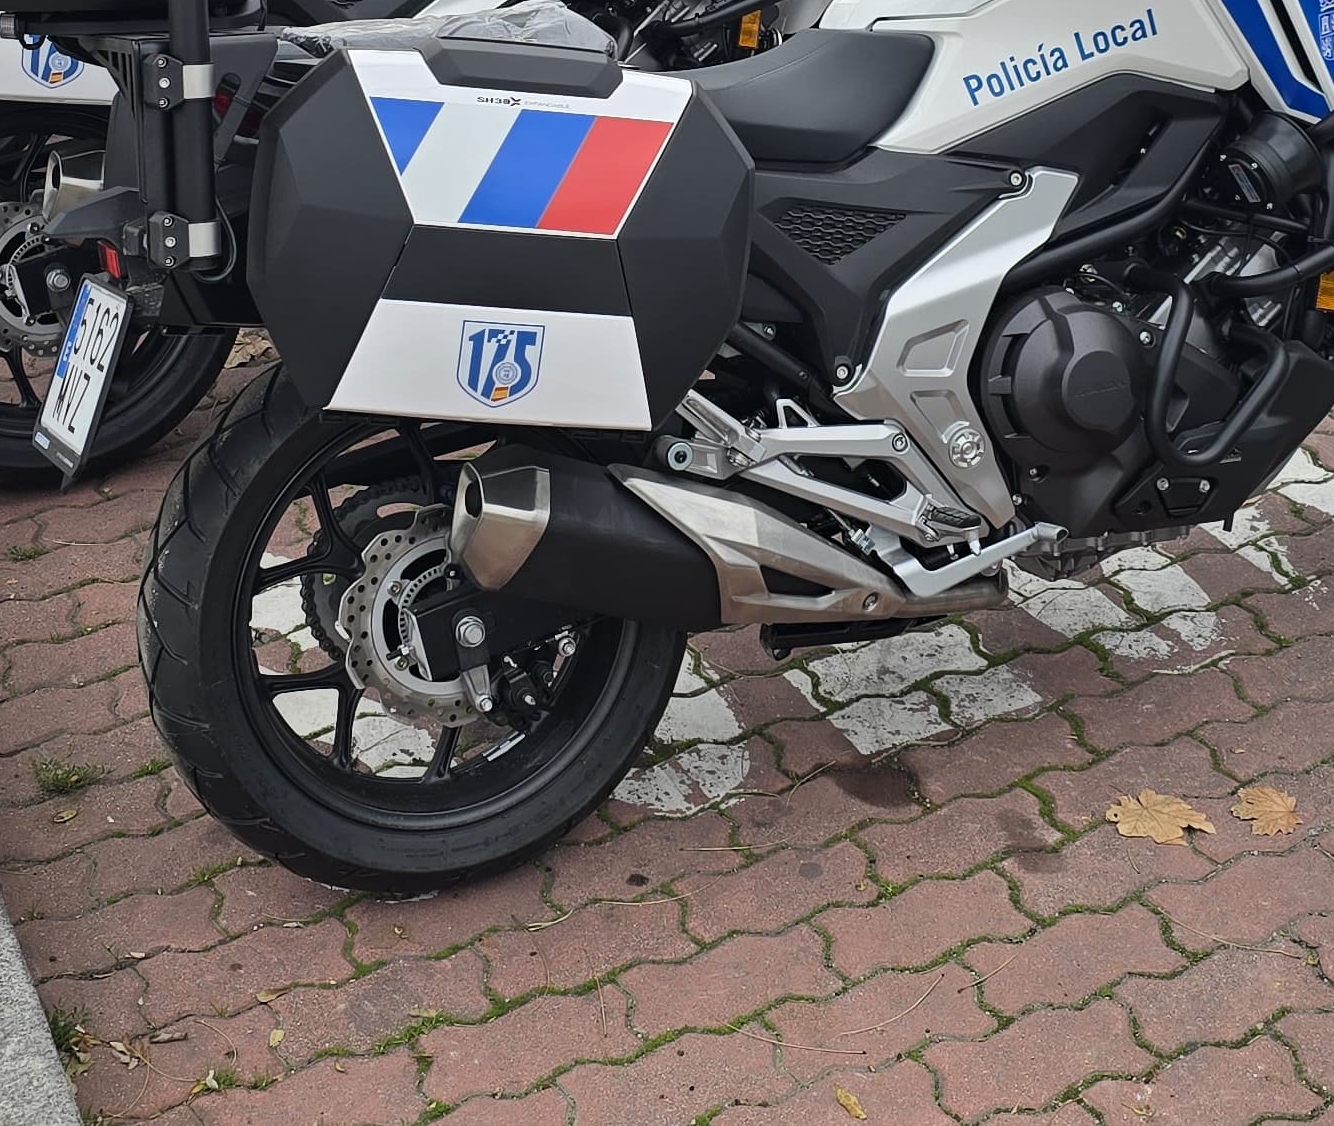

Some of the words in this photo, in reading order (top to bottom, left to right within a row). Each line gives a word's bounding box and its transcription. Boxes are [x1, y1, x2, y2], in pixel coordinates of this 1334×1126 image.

[962, 42, 1069, 106] Policía
[1073, 8, 1158, 61] Local
[73, 296, 120, 373] 5162
[467, 328, 538, 400] 175
